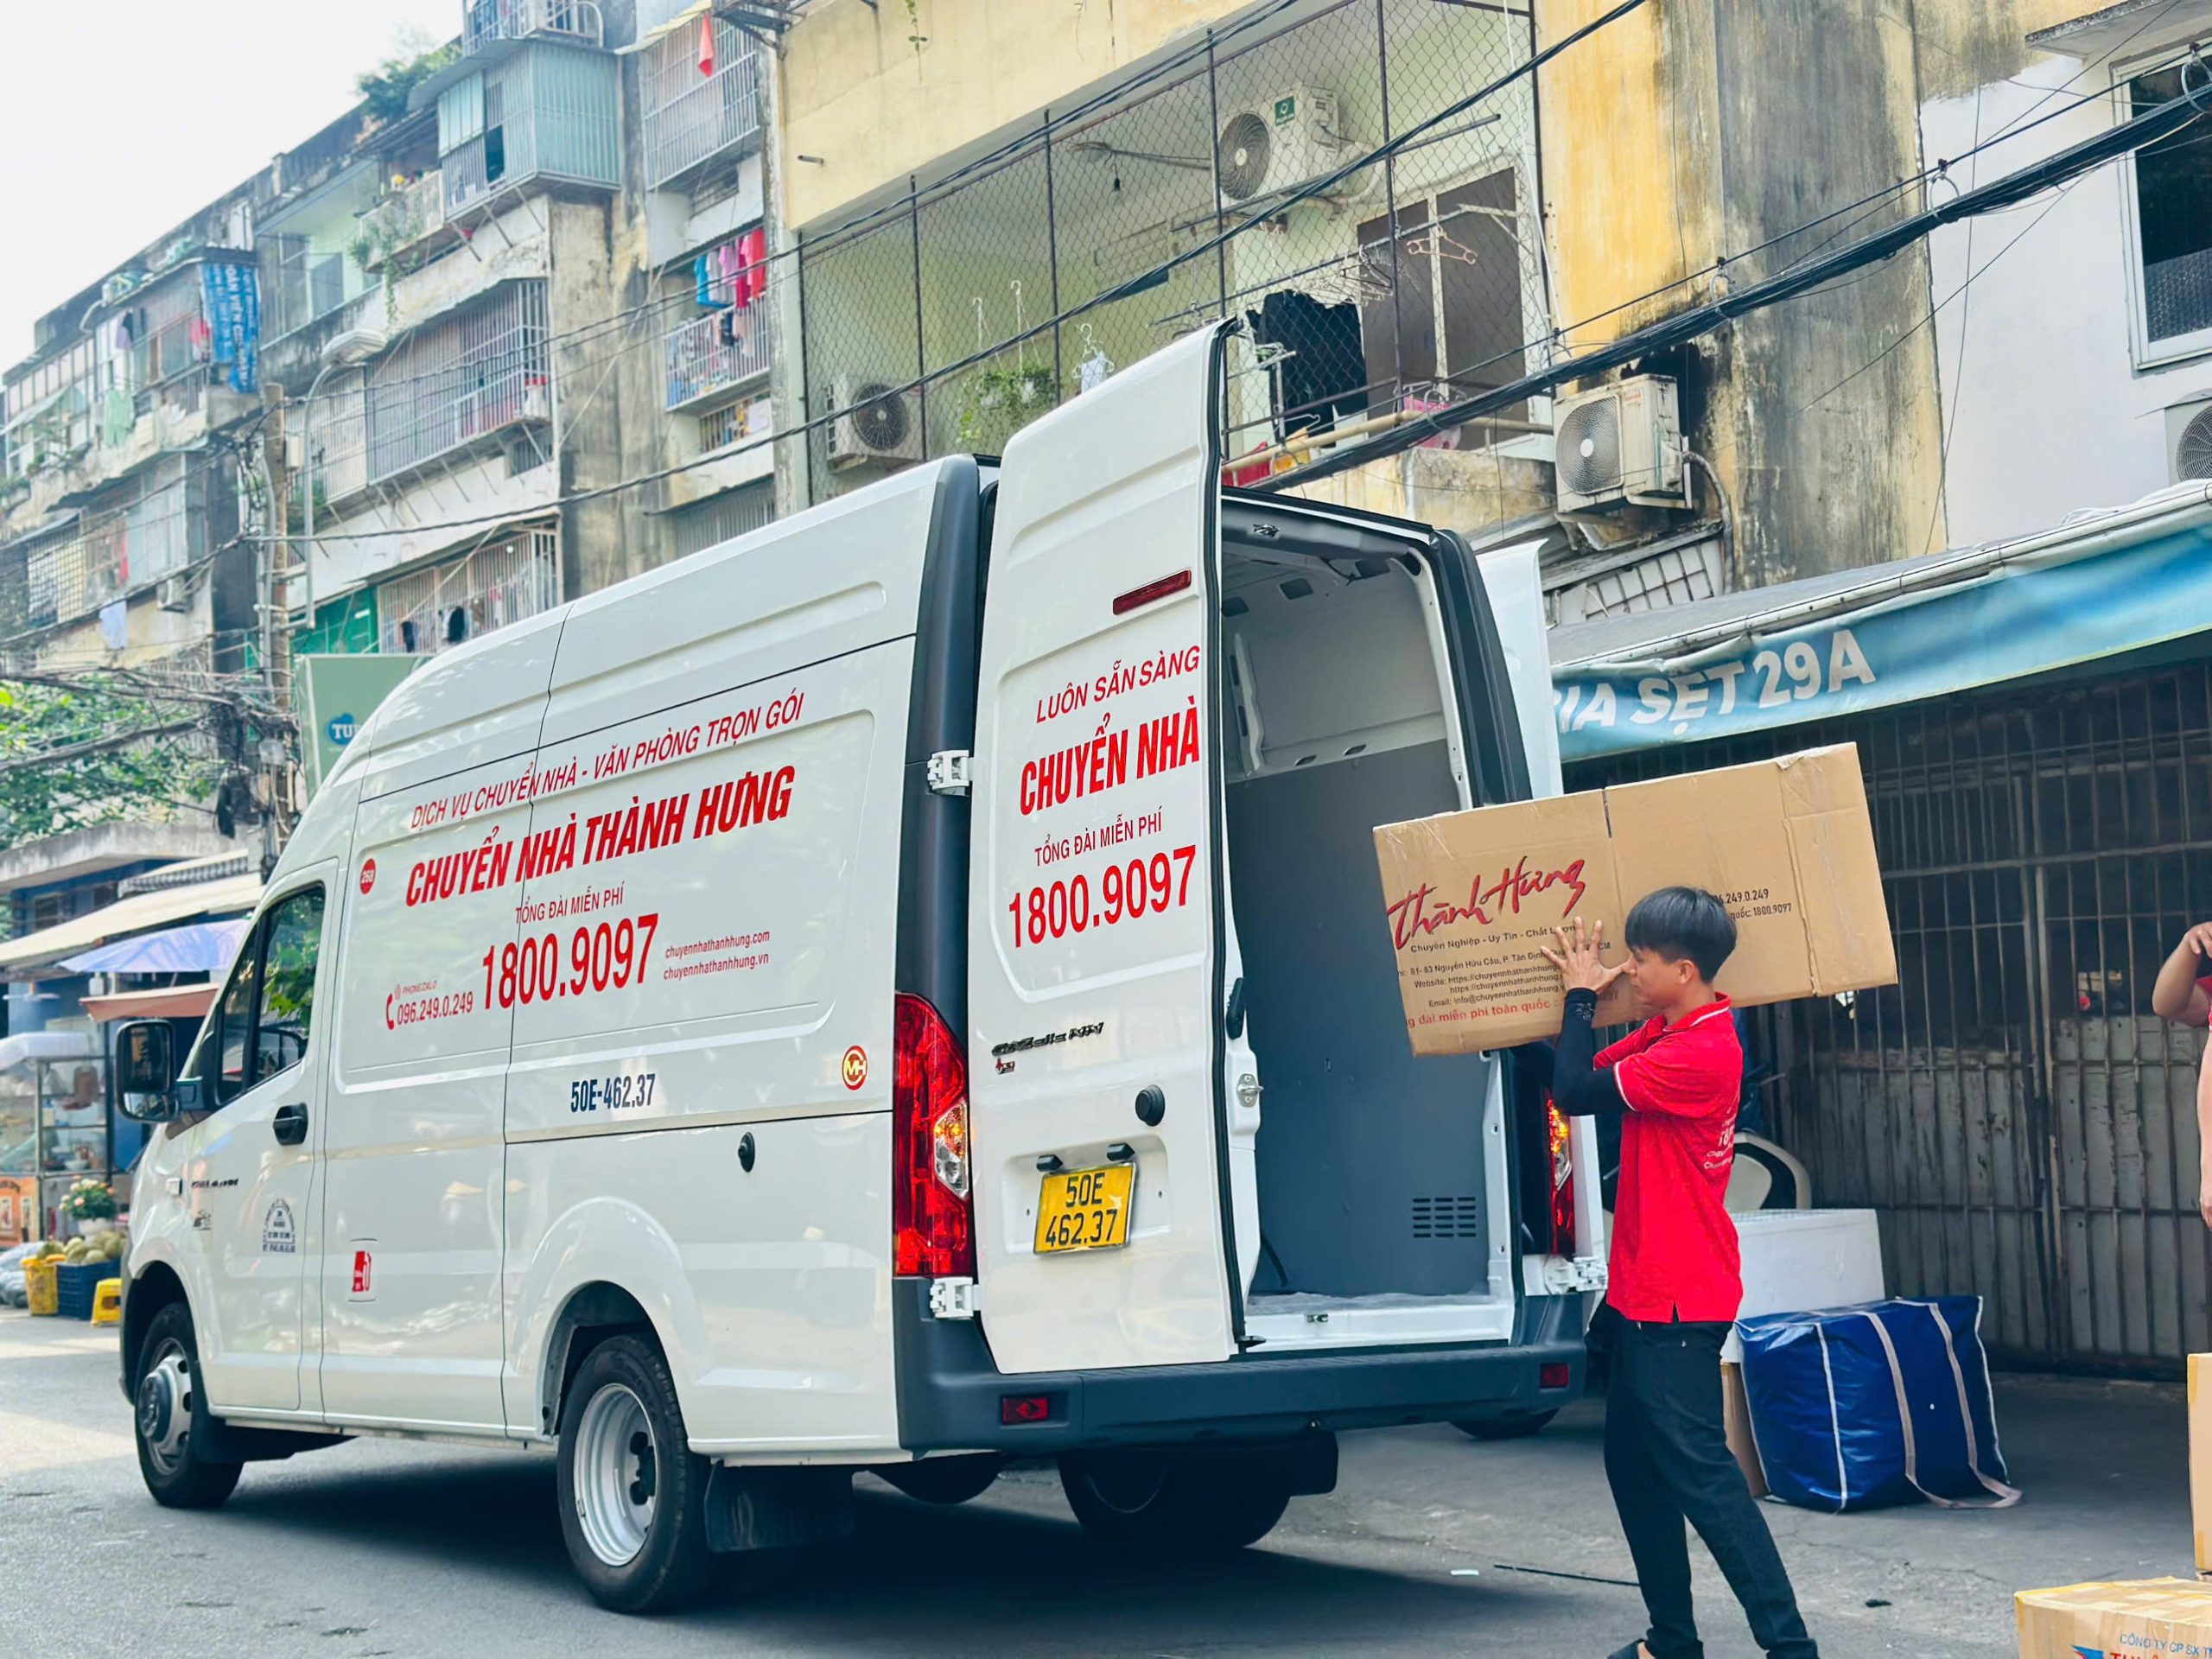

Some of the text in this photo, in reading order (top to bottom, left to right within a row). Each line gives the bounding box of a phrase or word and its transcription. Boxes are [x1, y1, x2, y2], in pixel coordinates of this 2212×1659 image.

[1037, 645, 1200, 724] LUÔN SẴN SÀNG
[1554, 686, 1616, 733] IA
[1629, 660, 1745, 735] SẸT
[410, 800, 447, 832] DỊCH
[452, 791, 472, 818] VỤ
[474, 761, 542, 812] CHUYỂN
[542, 756, 576, 794] NHÀ
[594, 745, 629, 777] VĂN
[633, 726, 701, 768] PHÒNG
[707, 708, 761, 747] TRỌN
[766, 688, 804, 728] GÓI
[1020, 695, 1200, 817] CHUYỂN NHÀ
[406, 766, 796, 907] CHUYỂN NHÀ THÀNH HƯNG
[1034, 805, 1163, 867] TỔNG ĐÀI MIỄN PHÍ
[516, 881, 624, 925] TỔNG ĐÀI MIỄN PHÍ
[1008, 844, 1197, 949] 1800.9097
[1753, 903, 1791, 917] 1800.9097
[482, 912, 659, 1011] 1800.9097
[665, 931, 770, 960] chuyennhathanhhung.com
[1488, 935, 1501, 944] Uy
[664, 953, 769, 981] chuyennhathanhhung.vn
[397, 991, 474, 1025] 096.249.0.249
[570, 1073, 656, 1113] 50E-462.37
[1065, 1172, 1106, 1208] 50E
[1045, 1209, 1118, 1247] 462.37
